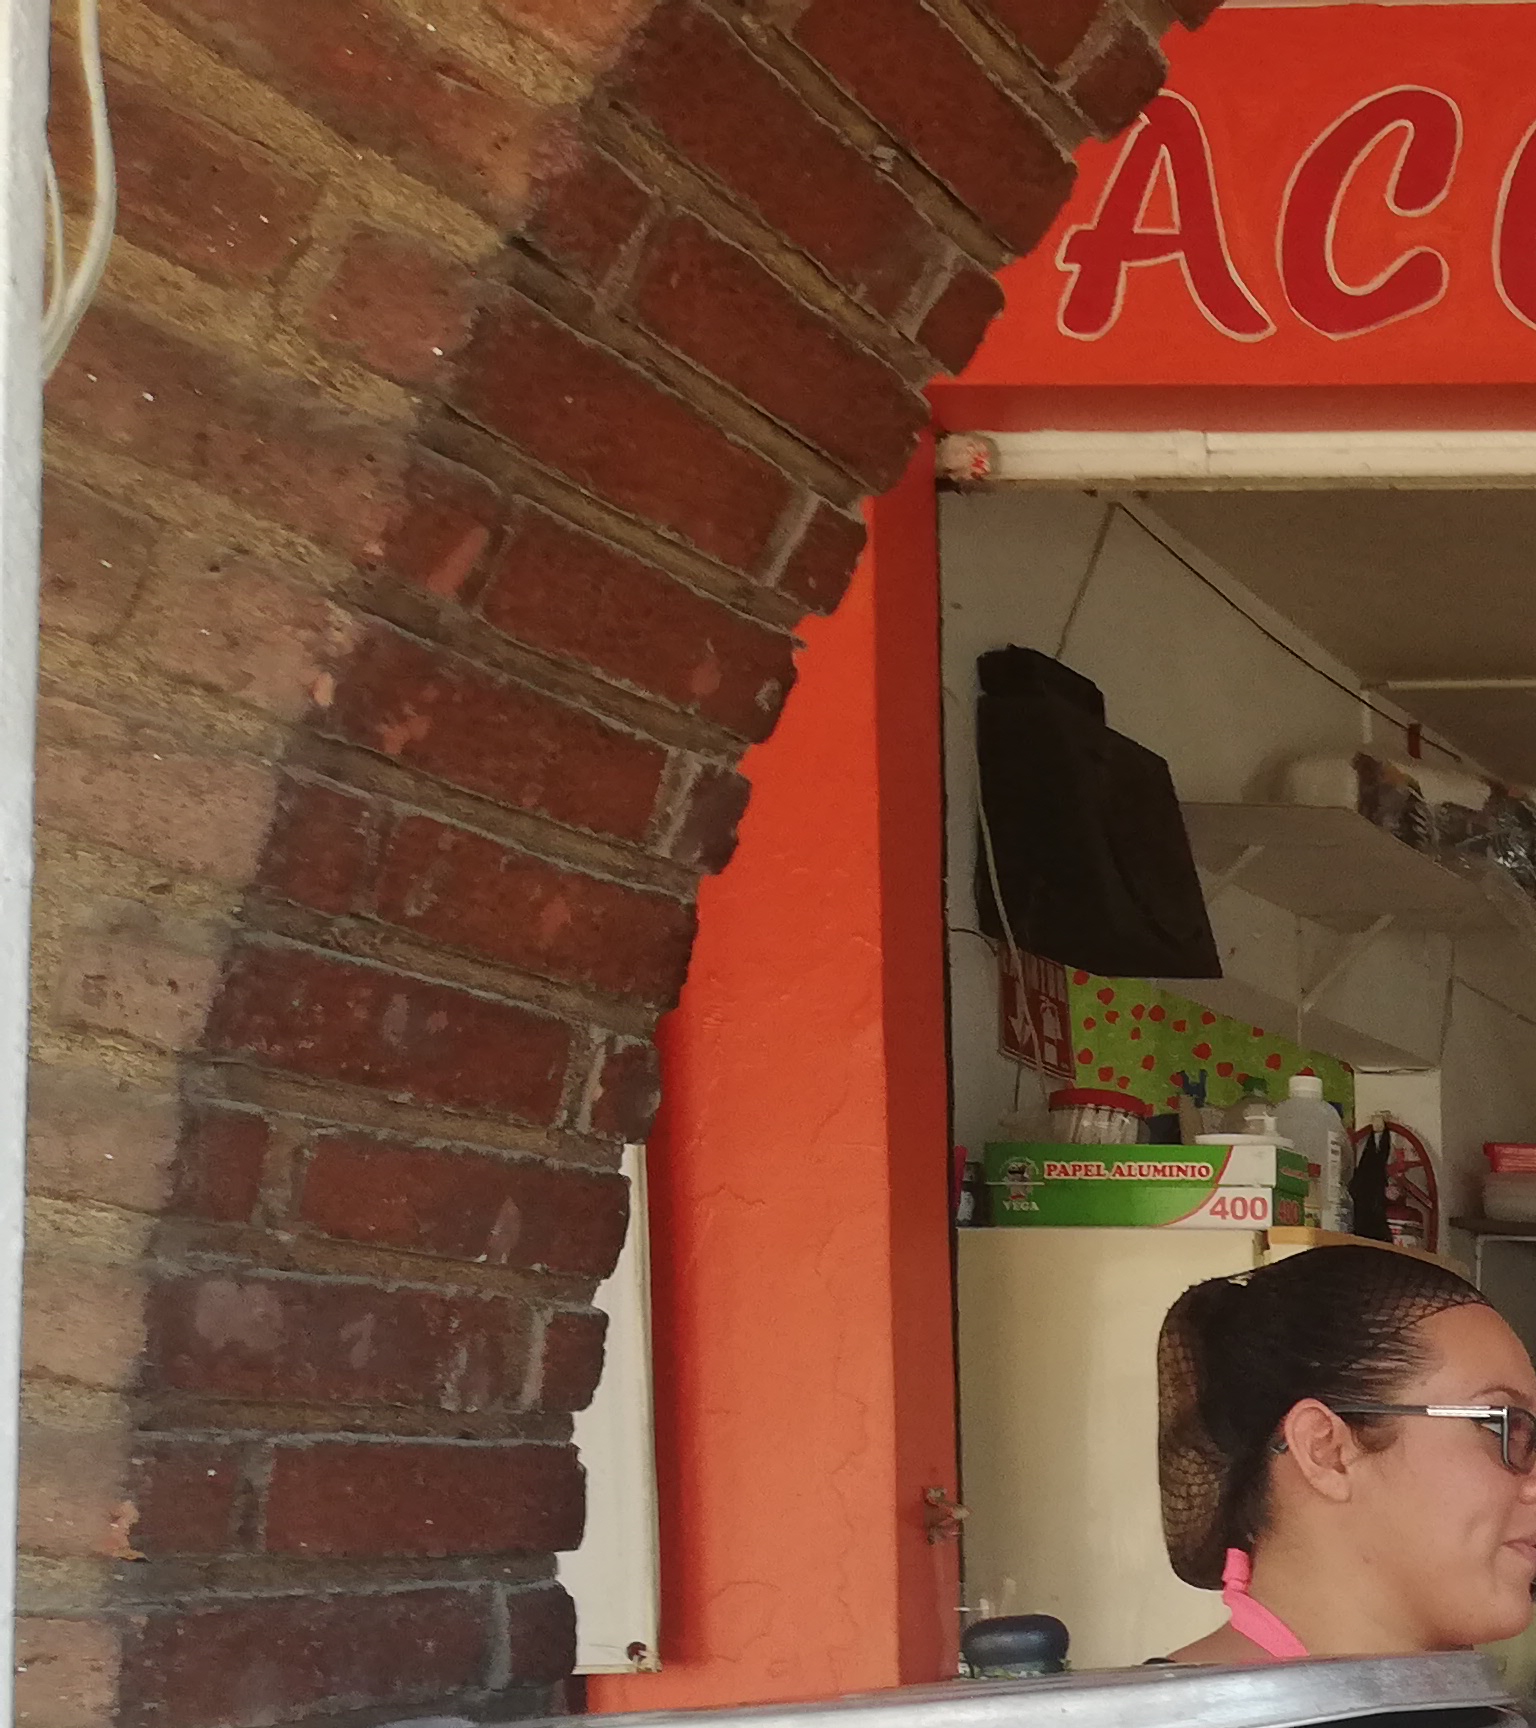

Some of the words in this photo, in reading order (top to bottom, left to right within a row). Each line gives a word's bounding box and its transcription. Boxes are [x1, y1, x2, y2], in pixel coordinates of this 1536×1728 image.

[1044, 1161, 1107, 1179] PAPEL
[1111, 1161, 1213, 1179] ALUMINIO
[1002, 1200, 1040, 1212] VEGA
[1208, 1195, 1270, 1221] 400
